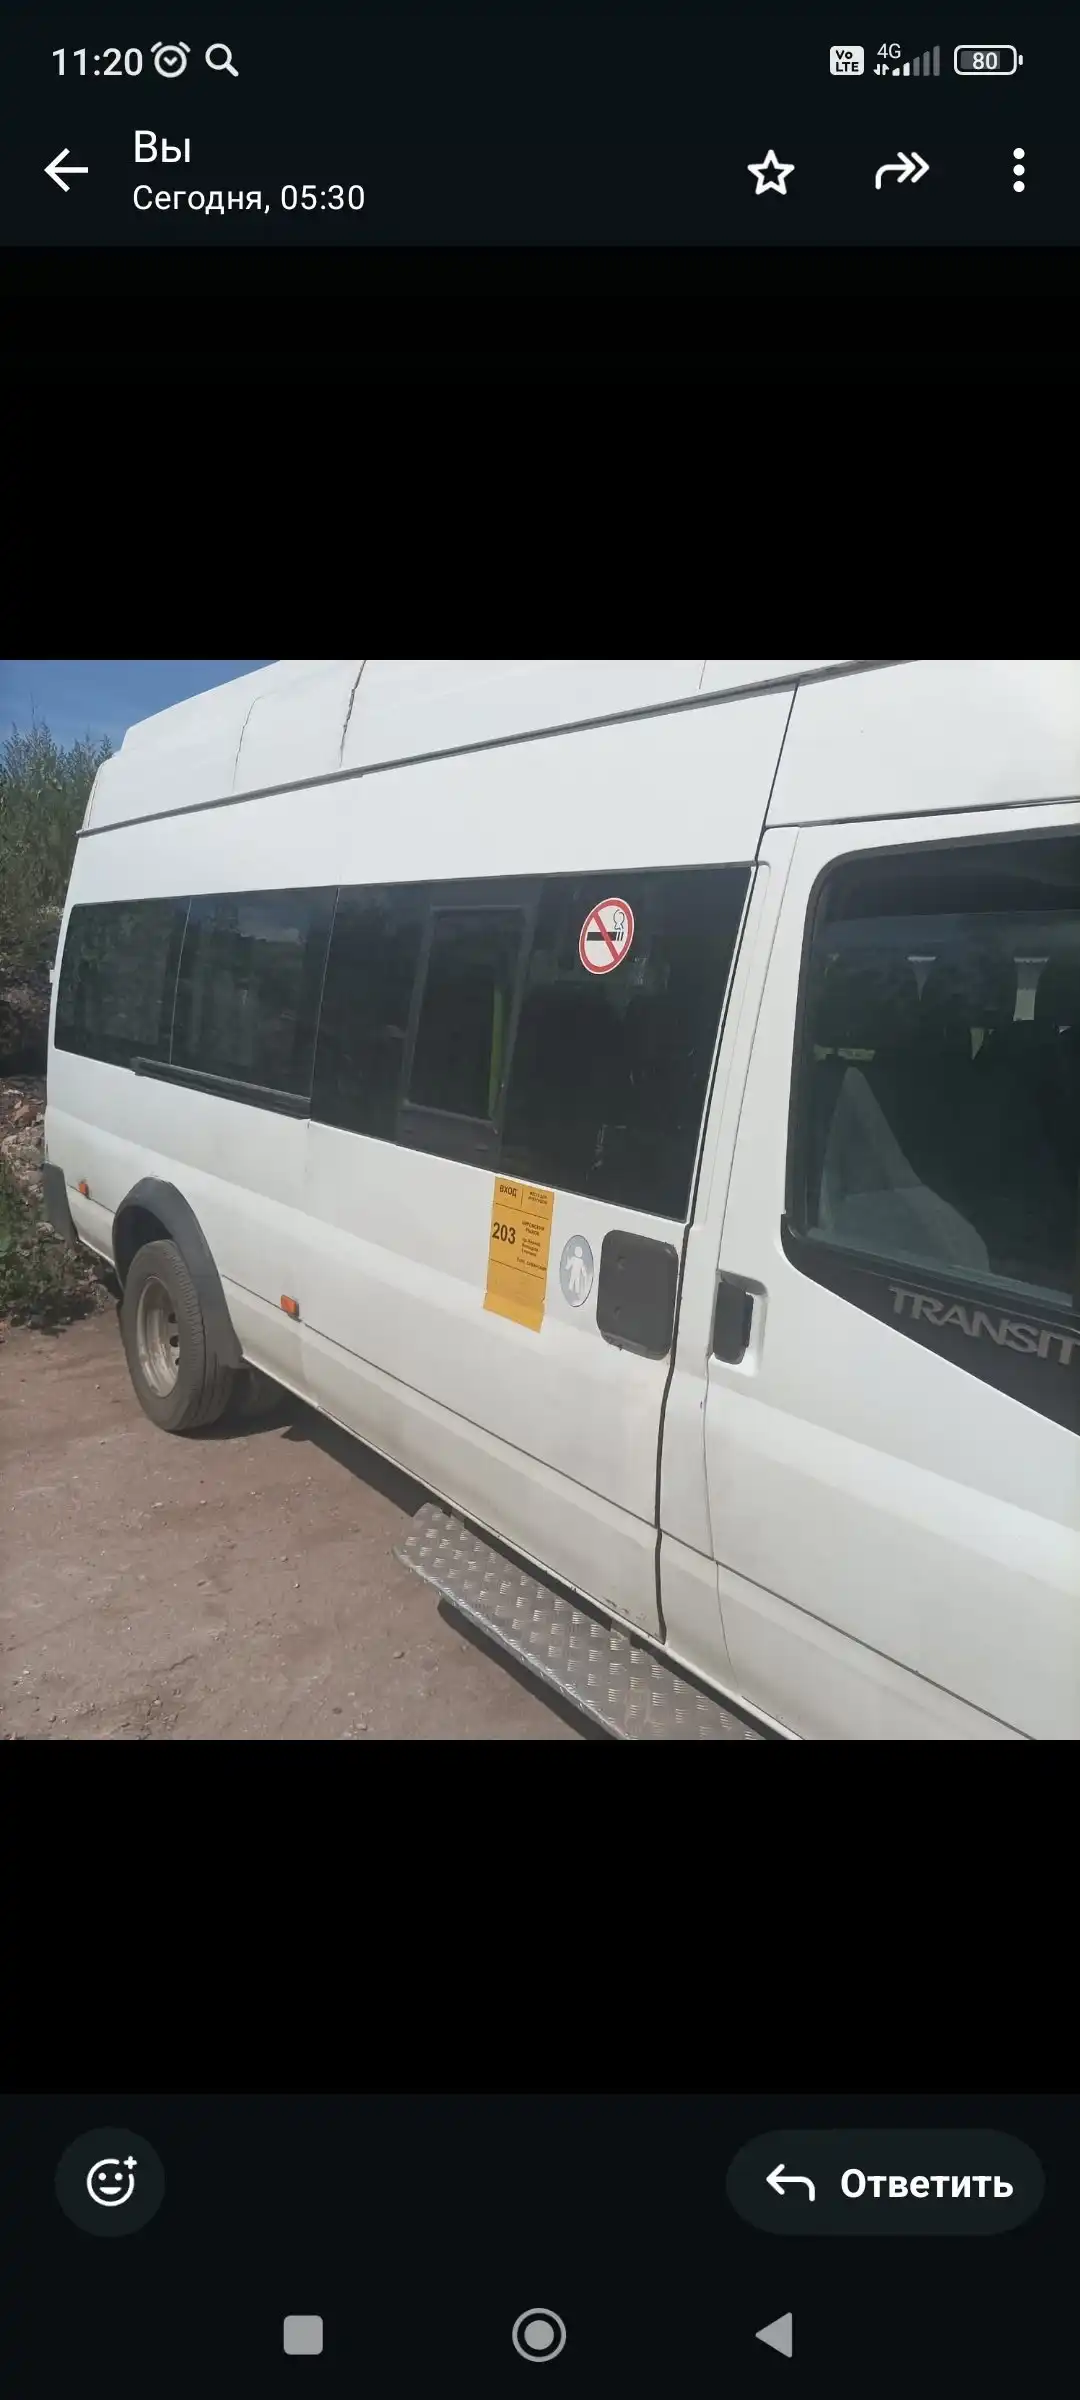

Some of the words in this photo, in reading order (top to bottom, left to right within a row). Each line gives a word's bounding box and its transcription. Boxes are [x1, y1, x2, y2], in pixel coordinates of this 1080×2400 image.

[499, 1184, 517, 1198] ВХОД
[492, 1221, 516, 1245] 203
[888, 1286, 1080, 1365] TRANSIT
